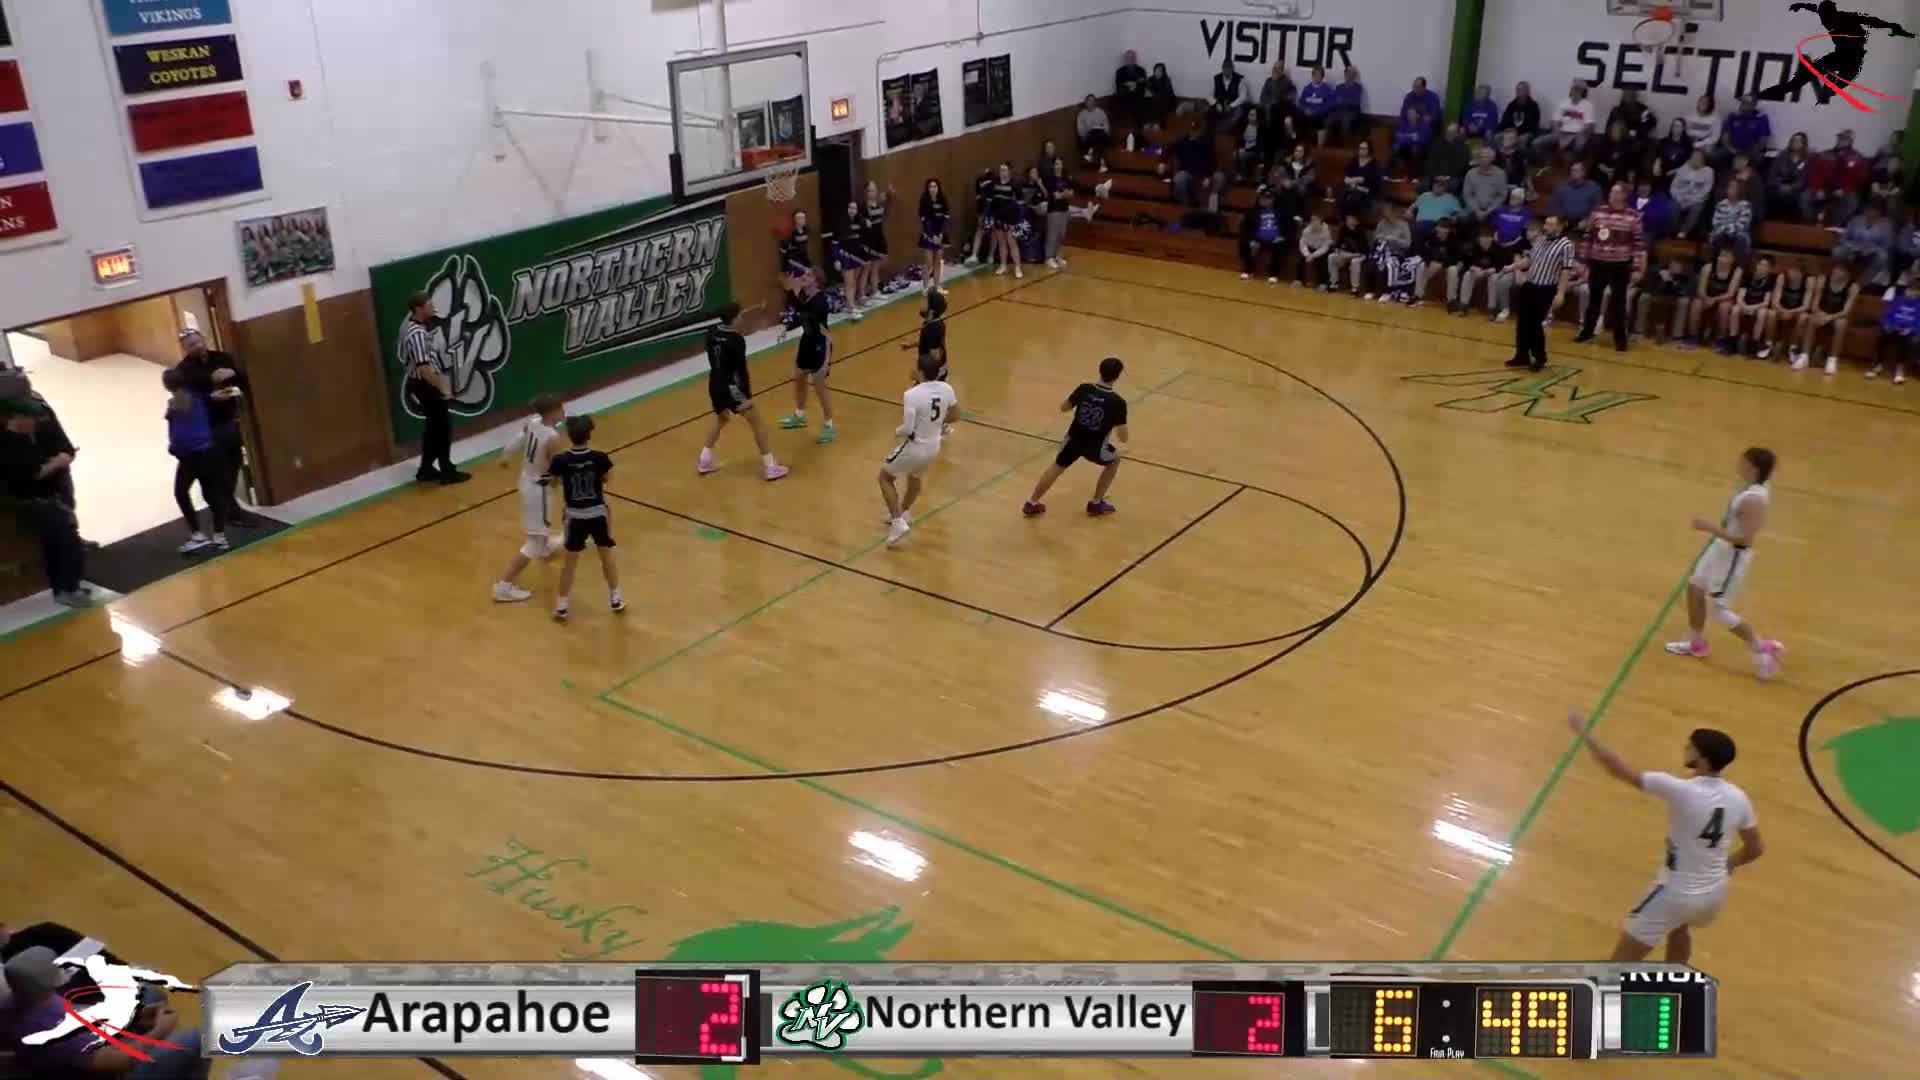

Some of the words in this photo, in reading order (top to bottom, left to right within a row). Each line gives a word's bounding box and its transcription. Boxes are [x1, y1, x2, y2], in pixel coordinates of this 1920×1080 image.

[138, 7, 202, 24] VIKINGS
[146, 45, 211, 62] WESKAN
[1200, 19, 1353, 69] VISITOR
[149, 64, 217, 84] COYOTES
[507, 215, 724, 325] NORTHERN
[564, 264, 713, 354] VALLEY
[930, 397, 941, 421] 5
[526, 431, 539, 464] 11
[1699, 807, 1725, 848] 4
[700, 982, 741, 1055] 2
[1247, 994, 1281, 1053] 2
[1658, 996, 1671, 1051] 1
